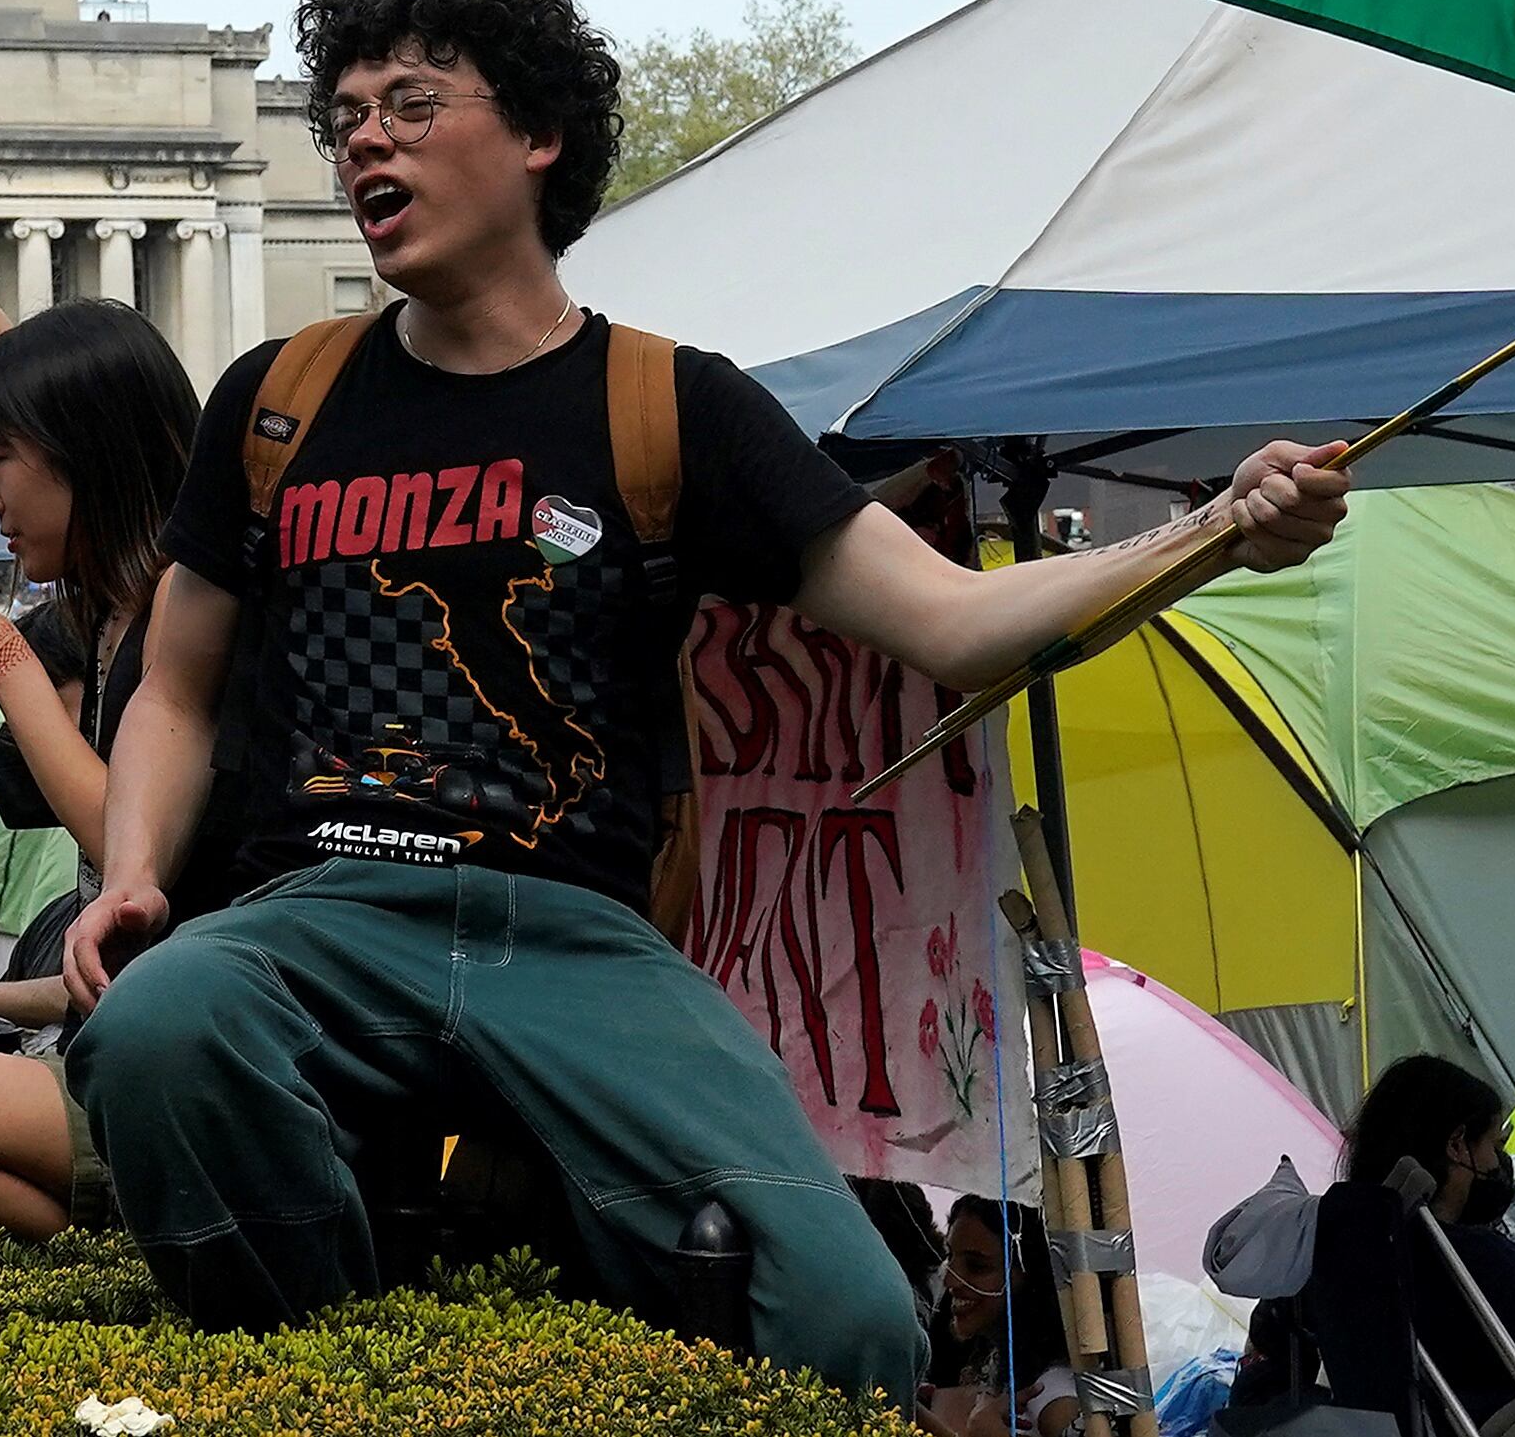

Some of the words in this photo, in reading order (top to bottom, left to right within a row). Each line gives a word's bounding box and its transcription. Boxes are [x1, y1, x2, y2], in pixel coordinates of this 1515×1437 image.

[535, 509, 599, 545] CEASEFIRE
[546, 527, 576, 547] NOW
[307, 821, 461, 854] McLaren
[317, 841, 381, 857] FORMULA
[405, 851, 444, 863] TEAM
